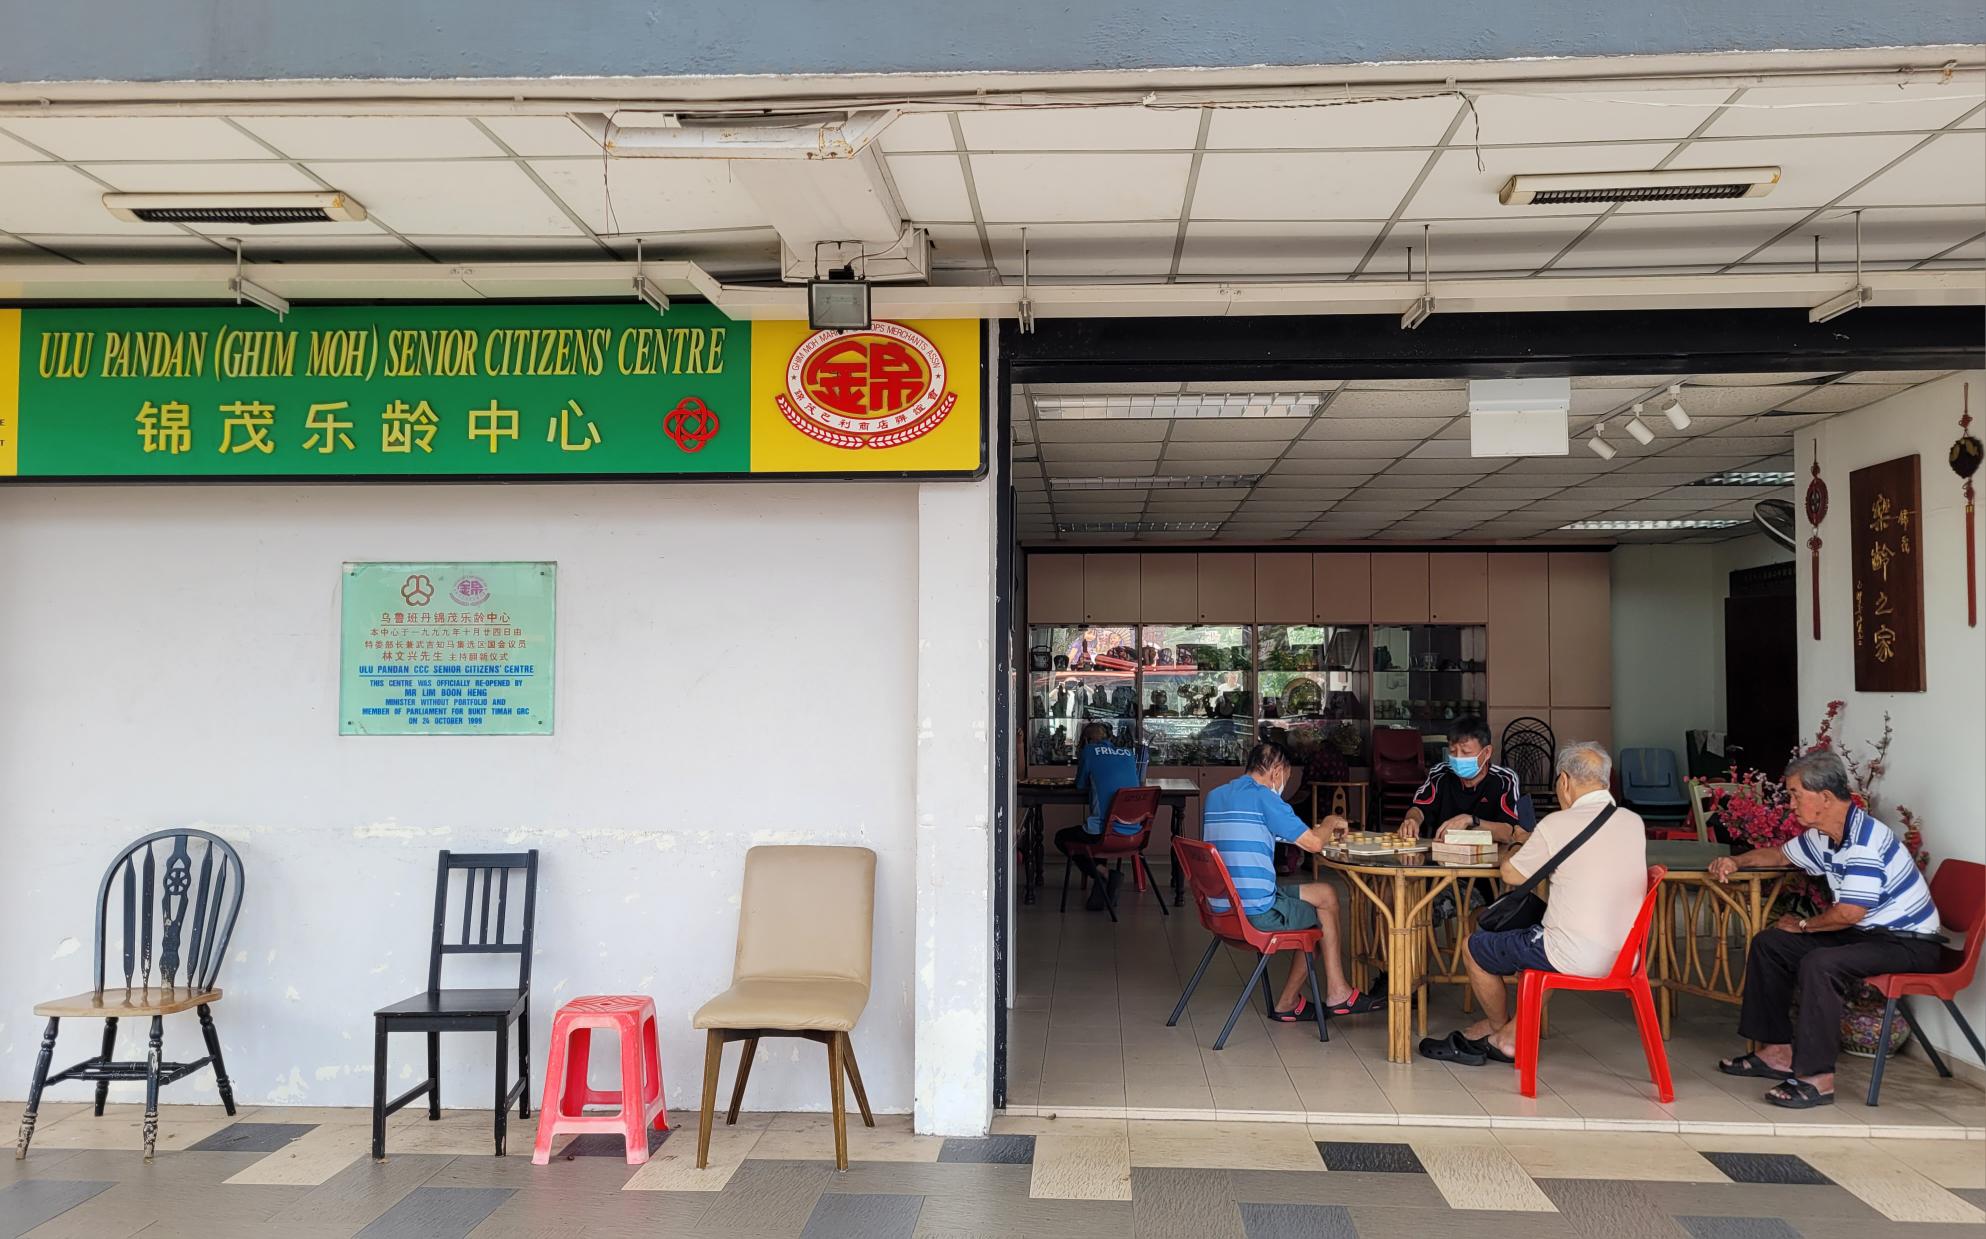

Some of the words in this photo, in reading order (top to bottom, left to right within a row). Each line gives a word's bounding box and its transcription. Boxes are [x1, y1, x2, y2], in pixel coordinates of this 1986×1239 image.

[39, 331, 94, 378] ULU
[101, 331, 207, 378] PANDAN
[214, 324, 299, 382] (GHIM
[305, 324, 379, 382] MOH)
[384, 329, 479, 377] SENIOR
[484, 328, 611, 376] CITIZENS'
[617, 327, 726, 376] CENTRE
[792, 351, 805, 371] GHIM
[803, 338, 819, 353] MOH
[886, 325, 928, 351] MERCHANTS
[927, 349, 941, 369] ASSN
[135, 399, 600, 455] 锦茂乐龄中心
[1869, 493, 1896, 663] 樂齡之家
[380, 611, 511, 624] 乌鲁班丹锦茂乐龄中心
[382, 651, 444, 662] 林文兴先生
[358, 665, 374, 674] ULU
[377, 665, 410, 674] PANDAN
[413, 664, 430, 674] CCC
[432, 664, 462, 674] SENIOR
[504, 664, 535, 674] CENTRE
[370, 679, 385, 687] THIS
[388, 679, 413, 687] CENTRE
[417, 679, 432, 687] WAS
[436, 679, 471, 687] OFFICIALLY
[474, 679, 511, 687] RE-OPENED
[514, 679, 523, 687] BY
[404, 688, 417, 697] MR
[421, 688, 436, 697] LIM
[440, 688, 462, 697] BOON
[466, 688, 488, 697] HENG
[385, 698, 416, 706] MINISTER
[420, 698, 449, 706] WITHOUT
[453, 698, 488, 706] PORTFOLIO
[492, 698, 506, 706] AND
[362, 707, 390, 715] MEMBER
[394, 707, 402, 715] OF
[406, 707, 448, 715] PARLIAMENT
[451, 707, 464, 715] FOR
[468, 707, 487, 715] BUKIT
[491, 707, 512, 715] TIMAH
[516, 707, 530, 715] GRC
[408, 717, 418, 725] ON
[422, 717, 430, 725] 24
[434, 717, 463, 725] OCTOBER
[467, 717, 483, 725] 1999
